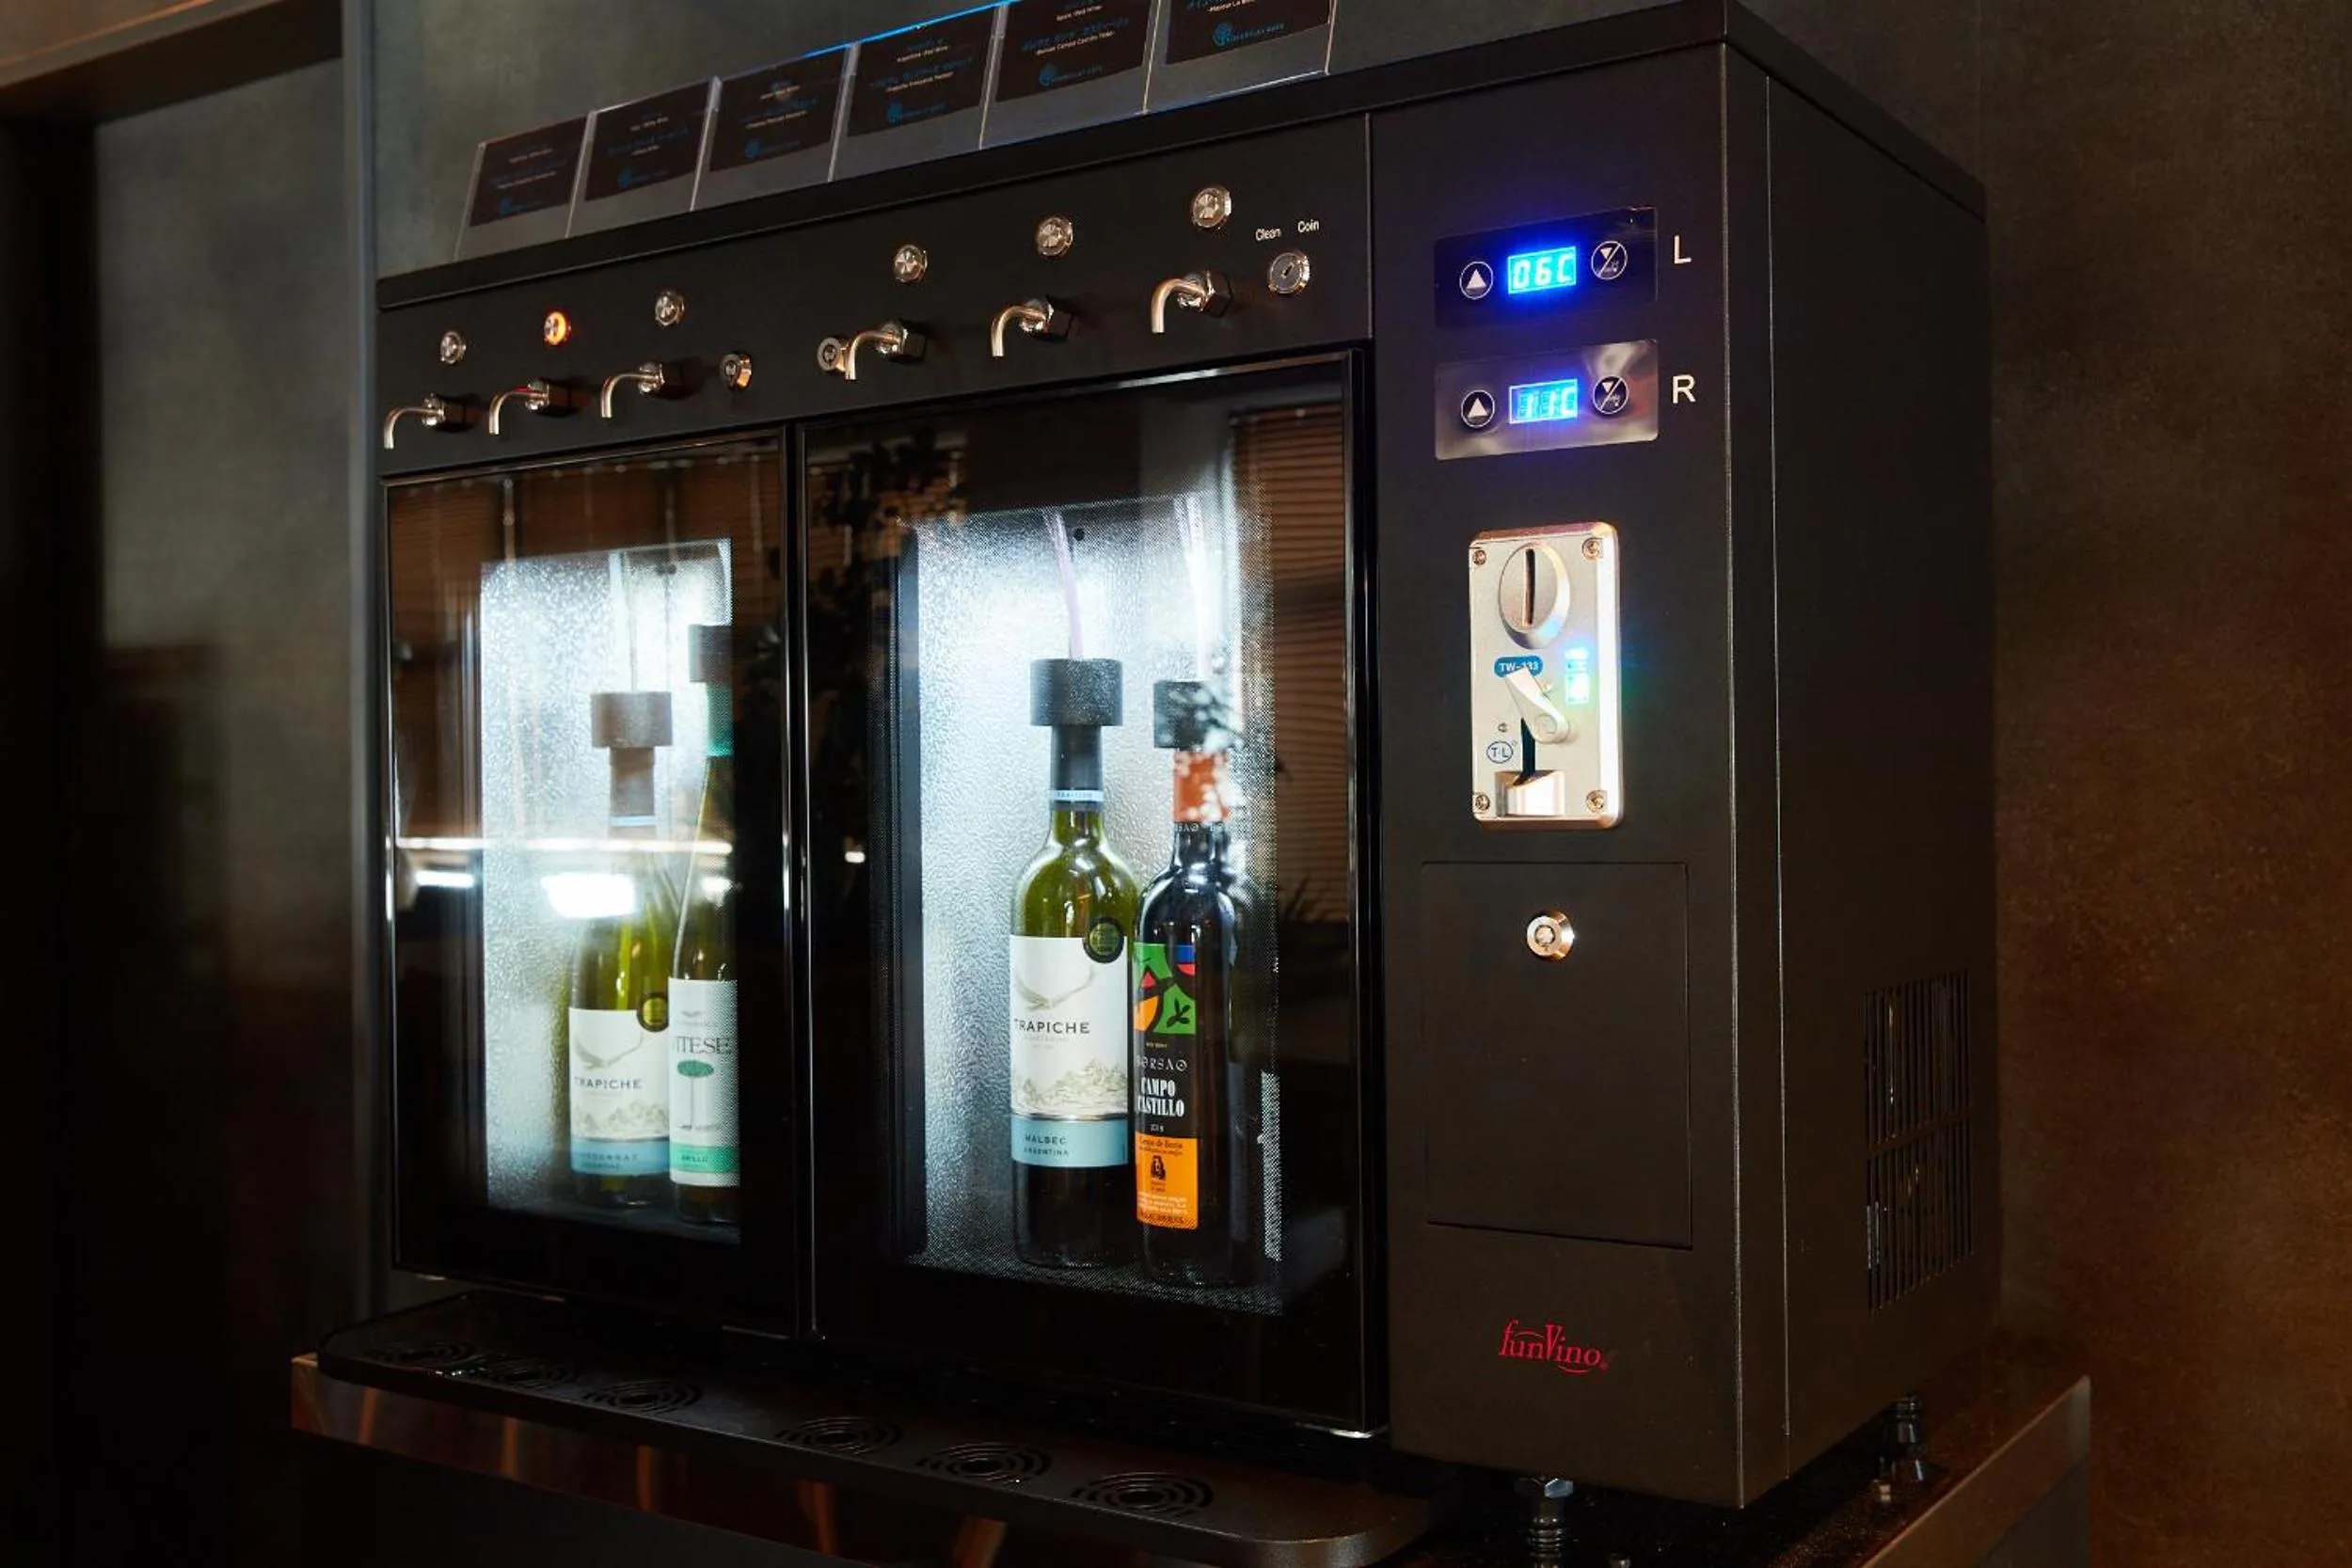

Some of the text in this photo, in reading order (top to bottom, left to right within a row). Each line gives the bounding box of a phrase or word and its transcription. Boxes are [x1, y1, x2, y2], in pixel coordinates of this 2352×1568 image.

[1255, 228, 1281, 241] Clean
[1297, 219, 1320, 233] Coin
[1674, 235, 1692, 264] L
[1513, 253, 1574, 289] 06C
[1672, 375, 1695, 404] R
